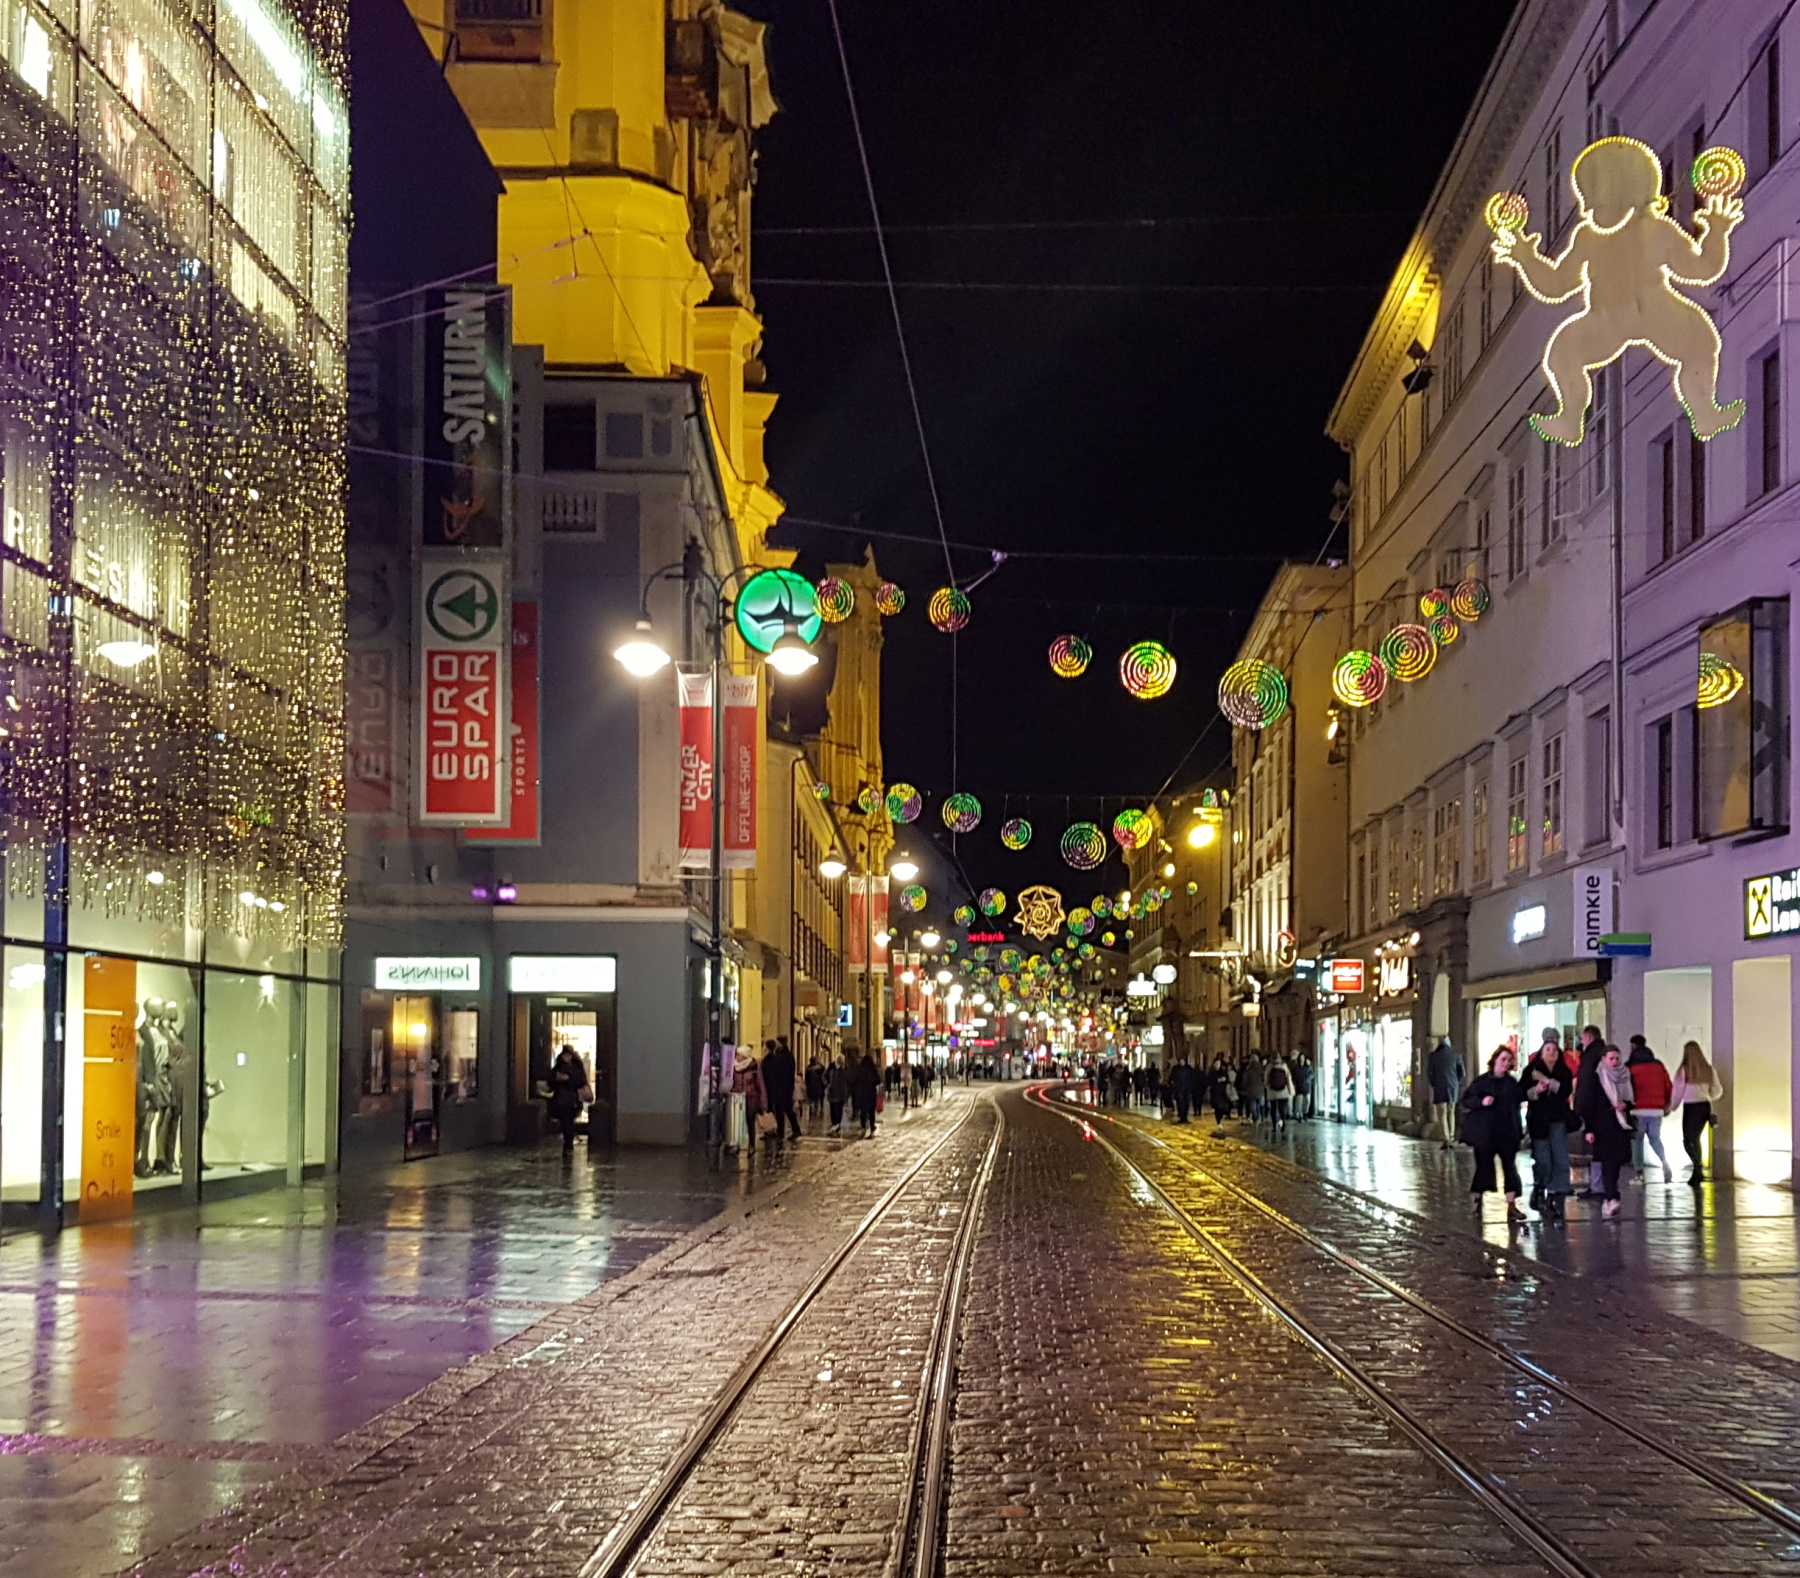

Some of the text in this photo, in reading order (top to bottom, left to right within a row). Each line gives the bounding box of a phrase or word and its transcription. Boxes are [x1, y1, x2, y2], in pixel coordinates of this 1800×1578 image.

[443, 292, 485, 447] SATURN
[432, 654, 459, 780] EURO
[463, 654, 490, 780] SPAR
[515, 737, 526, 795] SPORTS
[96, 1120, 121, 1139] Smile
